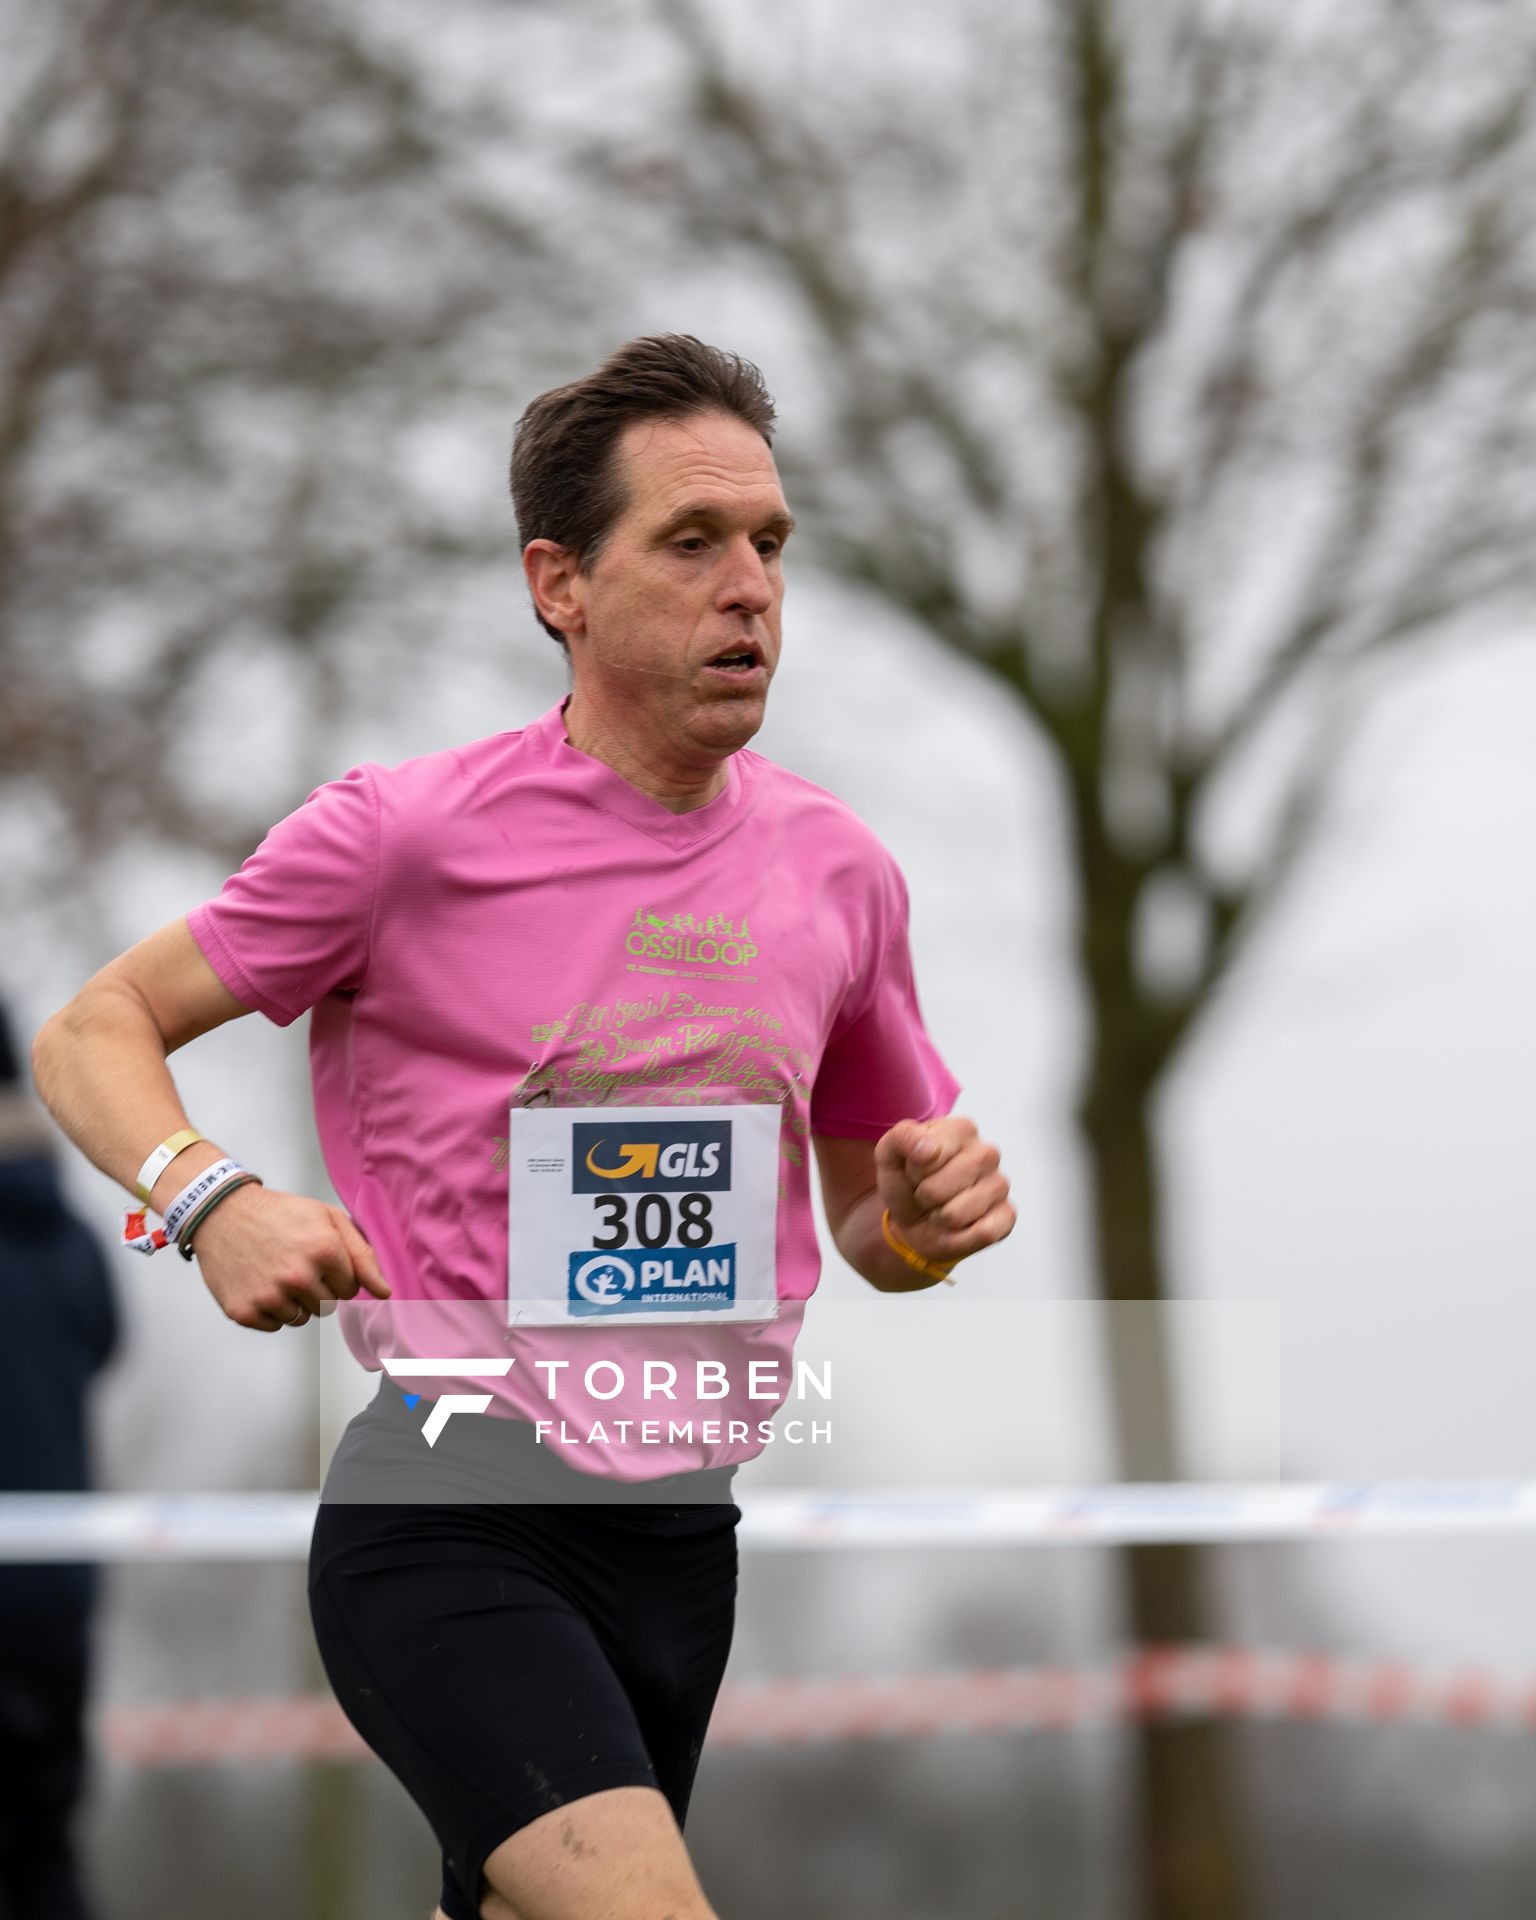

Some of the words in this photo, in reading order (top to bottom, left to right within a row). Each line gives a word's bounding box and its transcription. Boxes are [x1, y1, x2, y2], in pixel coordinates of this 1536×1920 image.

[625, 931, 758, 966] OSSILOOP
[659, 1142, 721, 1178] GLS
[592, 1193, 713, 1250] 308
[640, 1258, 731, 1289] PLAN
[640, 1291, 730, 1304] INTERNATIONAL
